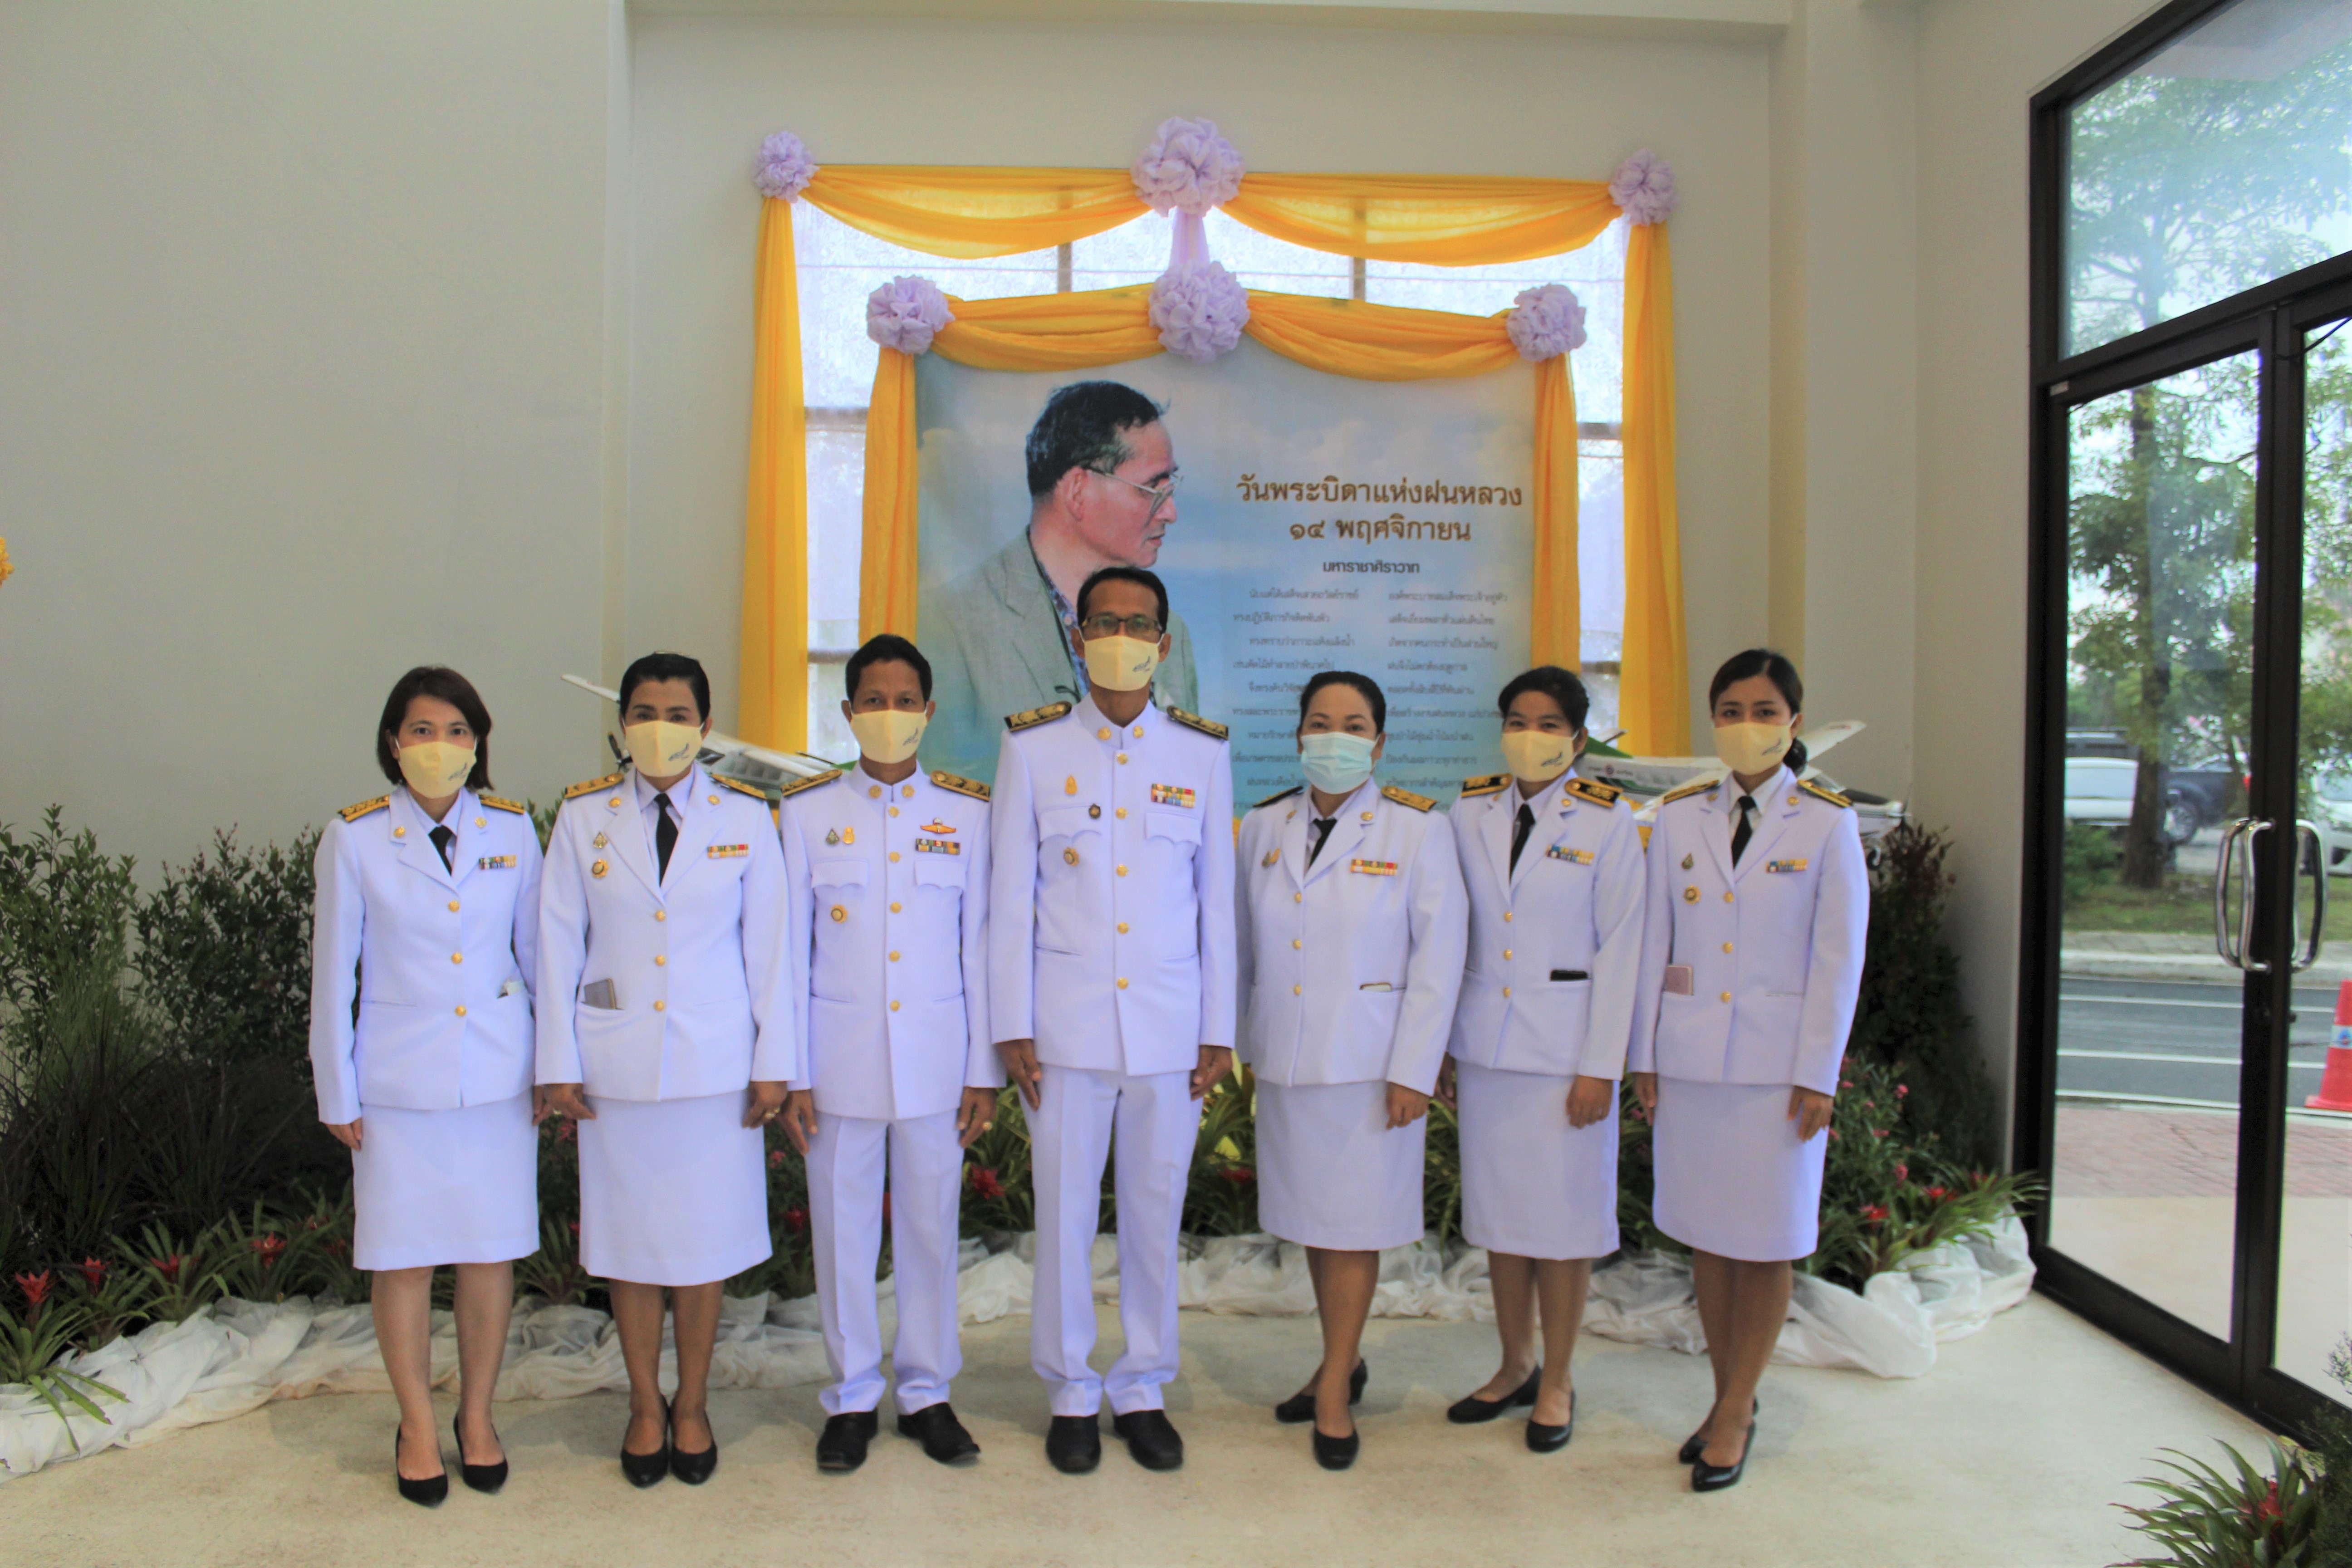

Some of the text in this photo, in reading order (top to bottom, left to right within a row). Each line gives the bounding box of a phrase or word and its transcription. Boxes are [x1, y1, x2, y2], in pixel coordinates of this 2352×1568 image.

[1236, 473, 1522, 505] วันพระบิดาแห่งฝนหลวง
[1289, 513, 1471, 544] ๑๔ พฤศจิกายน
